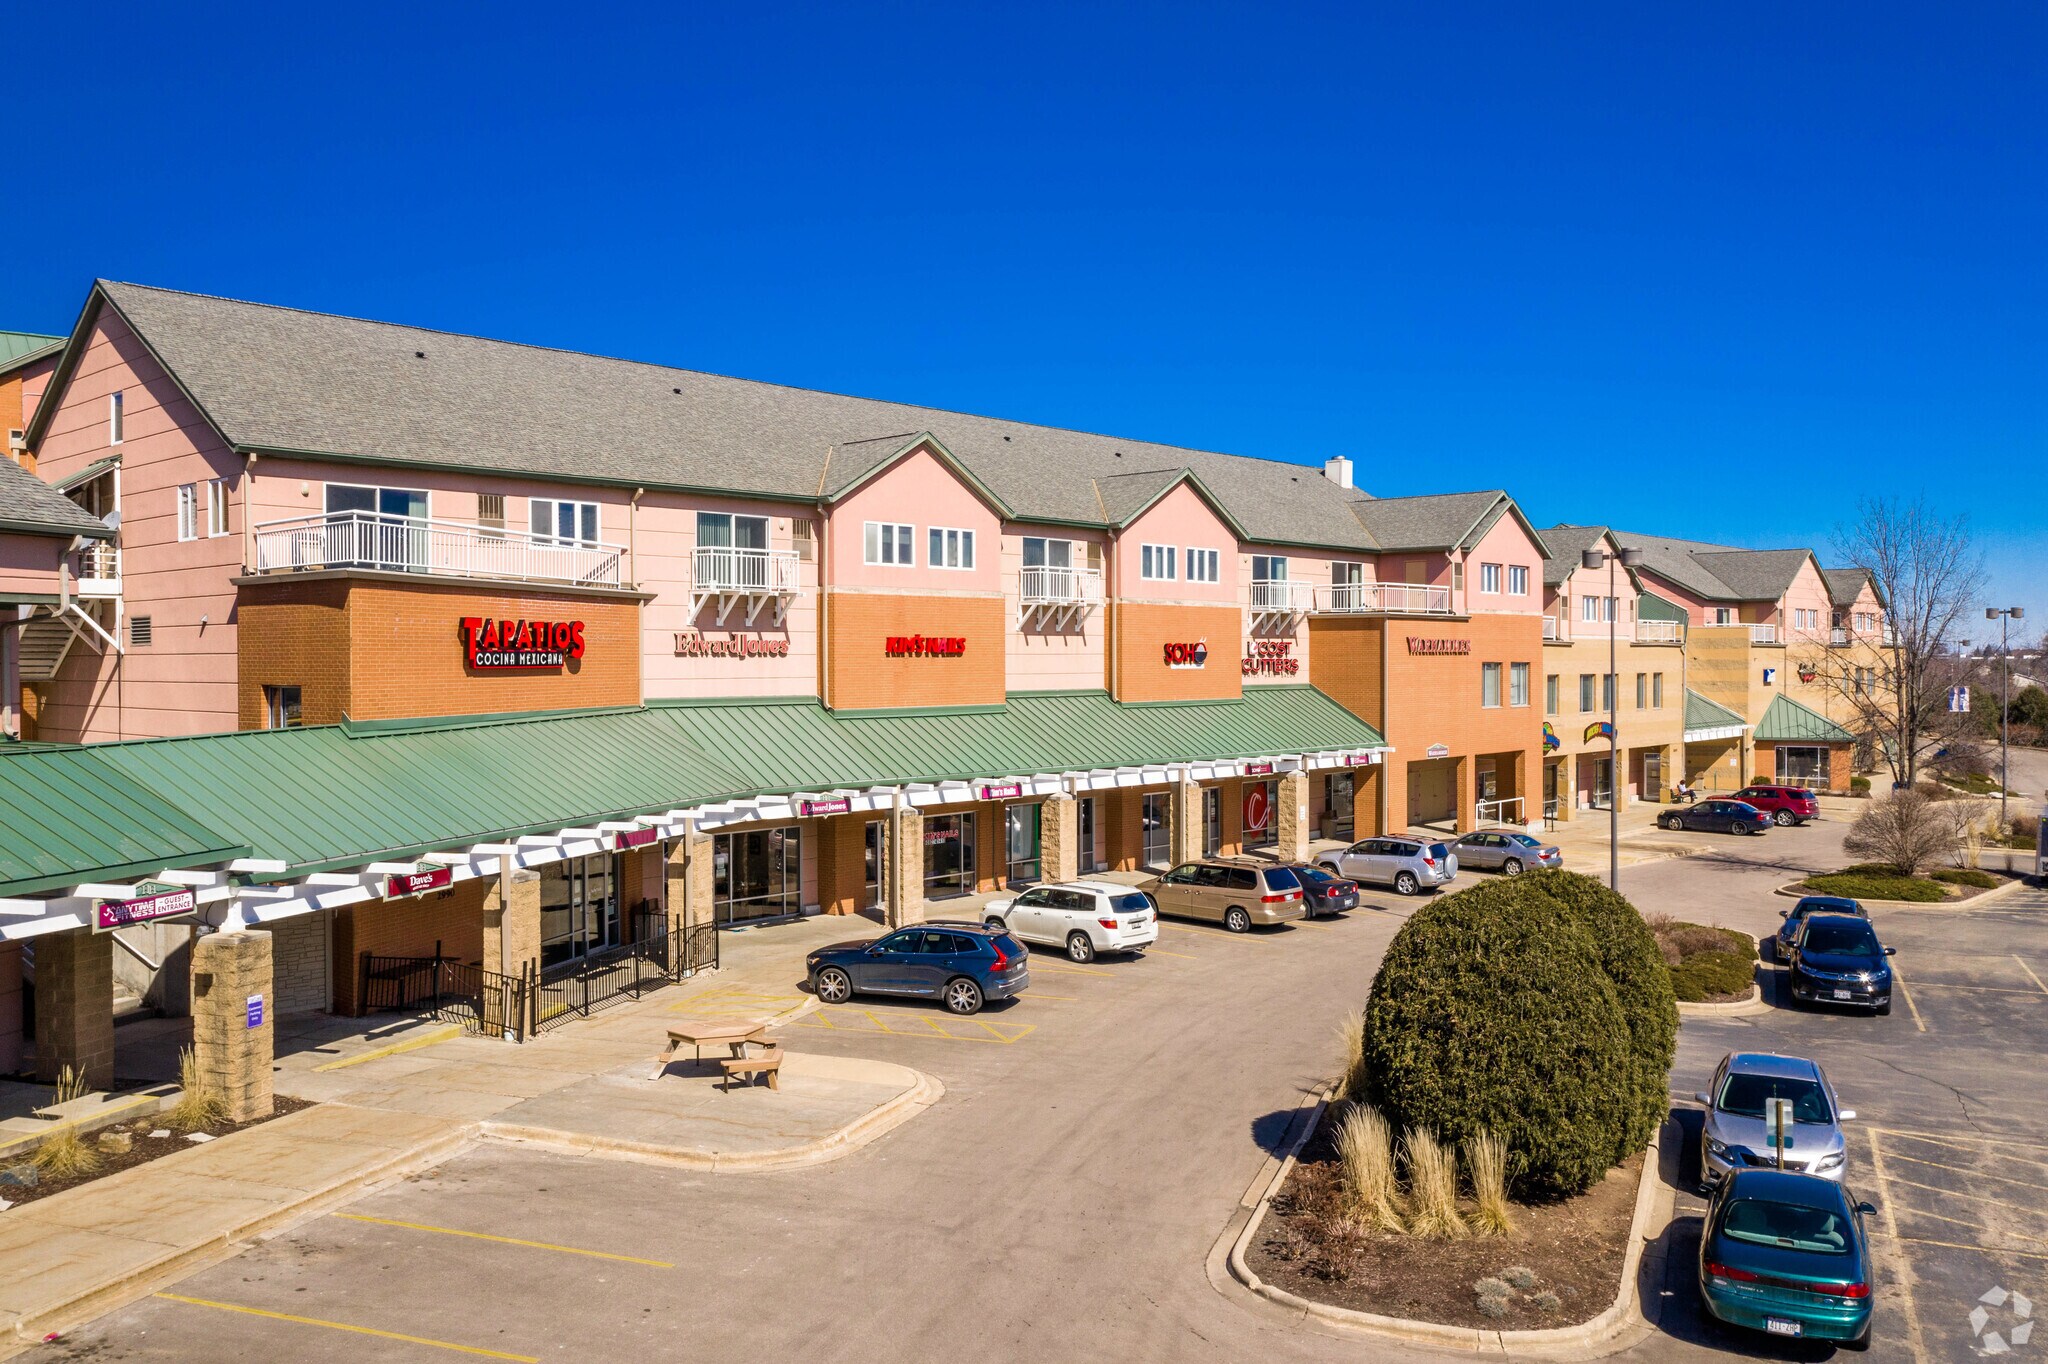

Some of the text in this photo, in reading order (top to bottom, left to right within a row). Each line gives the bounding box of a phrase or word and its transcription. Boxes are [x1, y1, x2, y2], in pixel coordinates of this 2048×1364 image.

[461, 617, 585, 660] TAPATIOS
[1259, 641, 1293, 655] COST
[476, 652, 563, 666] COCINA MEXICANA
[1243, 658, 1299, 673] CUTTERS
[409, 873, 433, 887] Dave's
[157, 900, 191, 913] ENTRANCE
[164, 894, 185, 905] GUEST
[115, 900, 155, 914] ANYTIME
[115, 908, 155, 920] FITNESS
